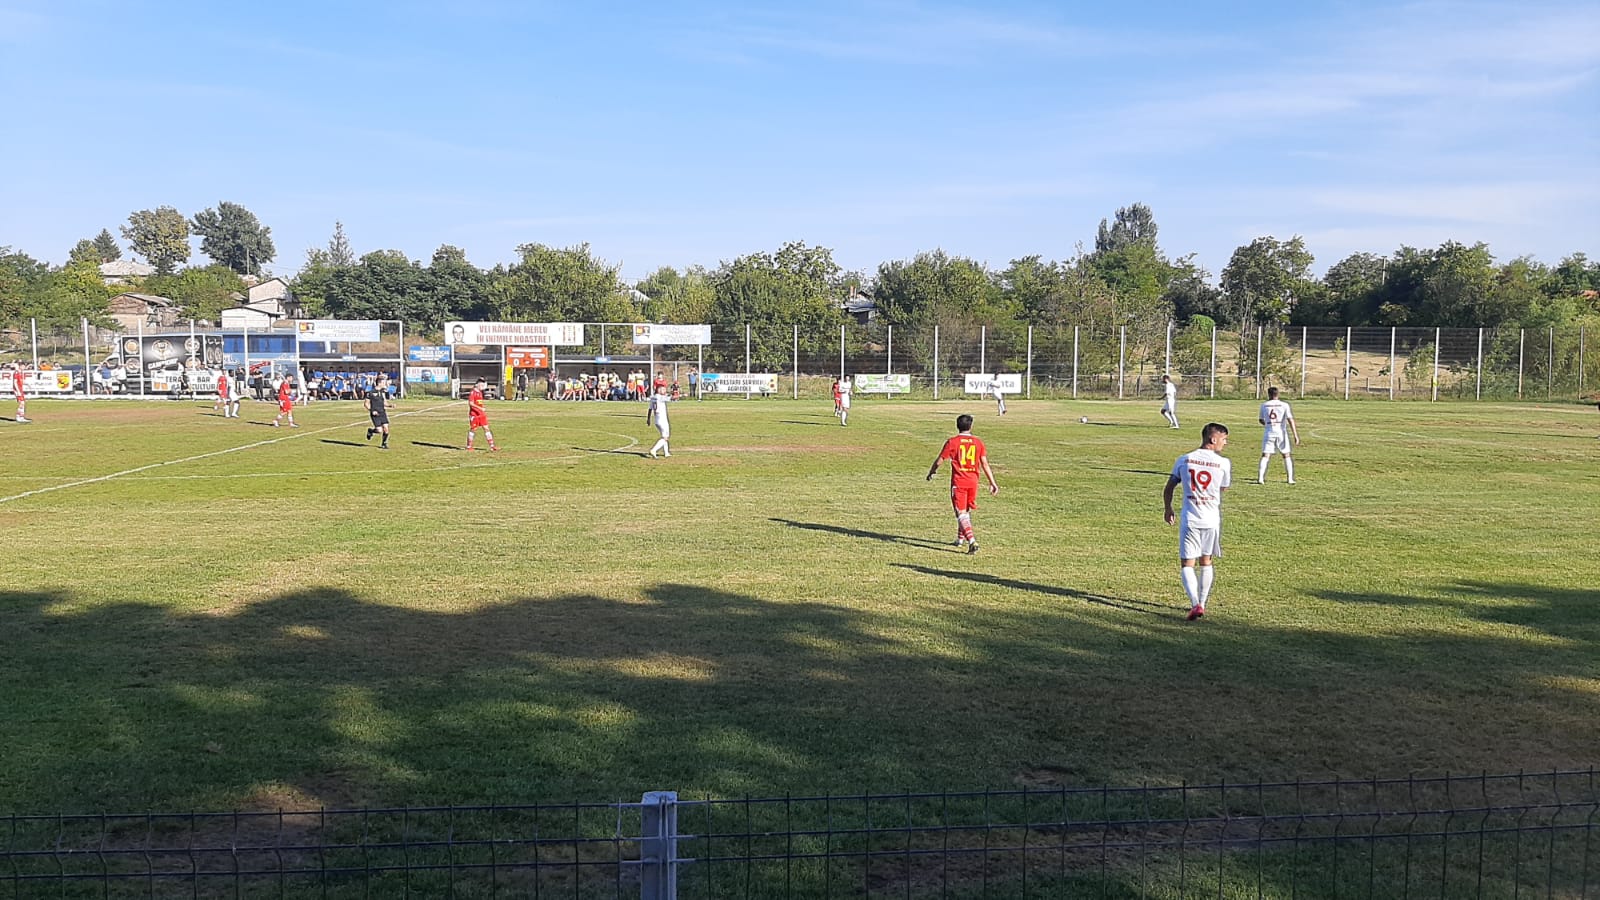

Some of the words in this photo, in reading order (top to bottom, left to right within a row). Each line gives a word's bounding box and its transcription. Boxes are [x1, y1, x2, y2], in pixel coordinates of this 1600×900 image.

[523, 325, 548, 334] MEREU
[485, 335, 513, 343] INIMILE
[514, 335, 546, 343] NOASTRE
[1268, 409, 1277, 420] 6
[959, 444, 976, 465] 14
[1188, 468, 1212, 492] 19
